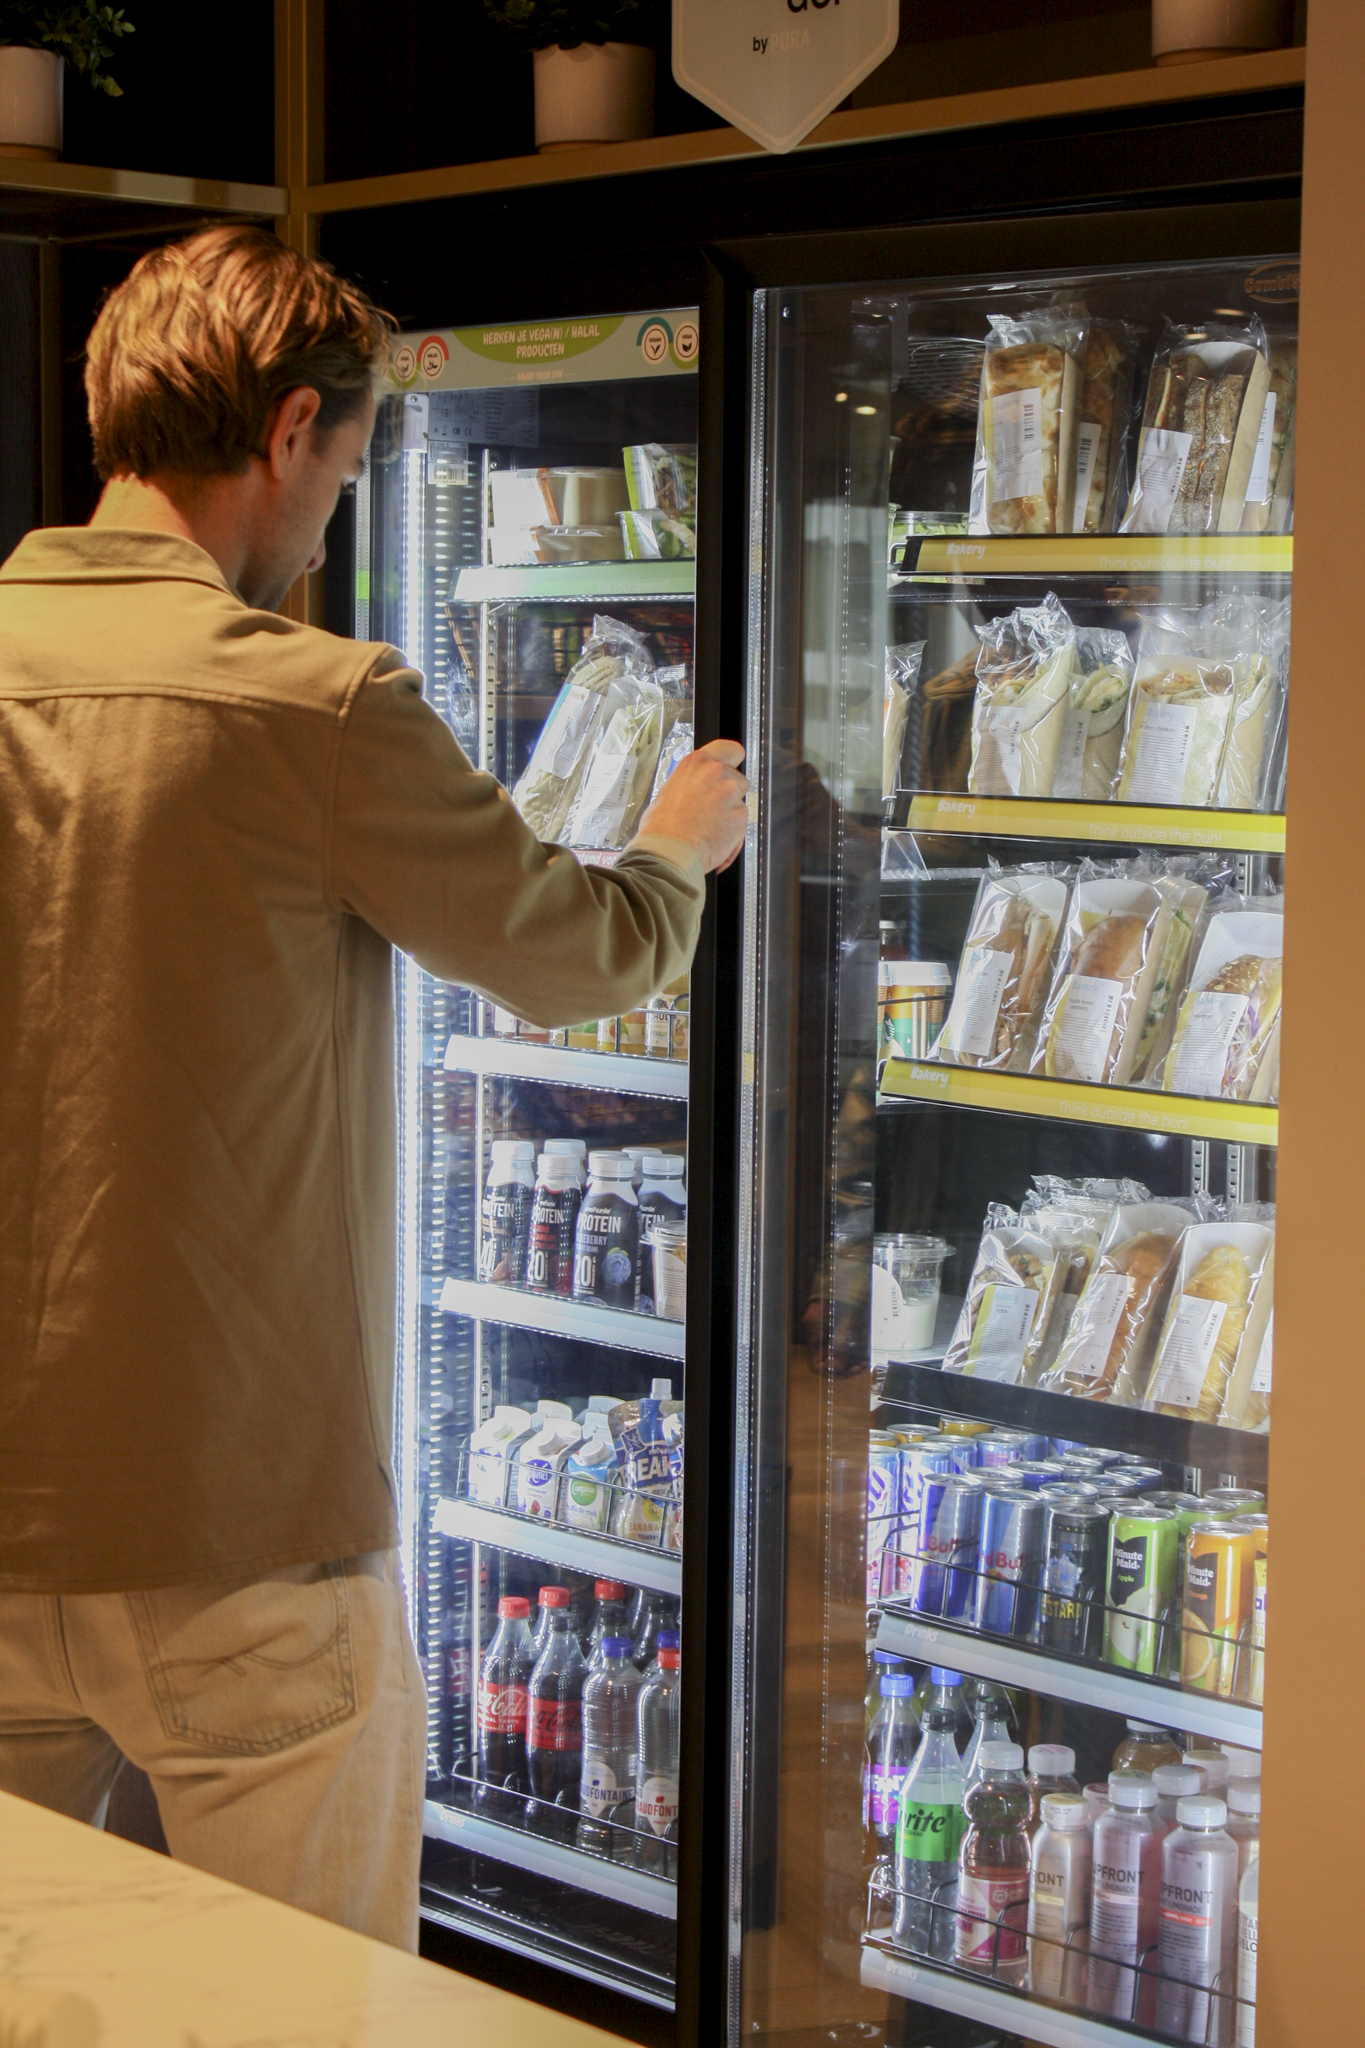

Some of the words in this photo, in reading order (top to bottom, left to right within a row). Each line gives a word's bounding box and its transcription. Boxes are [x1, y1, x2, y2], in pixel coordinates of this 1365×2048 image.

[753, 36, 768, 54] by
[770, 27, 811, 52] PURA
[483, 330, 515, 345] HERKEN
[517, 330, 527, 342] JE
[529, 326, 563, 341] VEGA(N)
[571, 324, 600, 338] HALAL
[516, 343, 565, 359] PRODUCTEN
[517, 373, 534, 381] ENJOY
[551, 369, 563, 379] DAY
[946, 543, 985, 558] Bakery
[1098, 557, 1128, 569] Think
[1130, 556, 1178, 569] outside
[1180, 556, 1201, 569] the
[1203, 556, 1234, 569] bun!
[597, 582, 611, 593] Eat
[612, 583, 632, 593] your
[634, 580, 669, 593] greens!
[937, 799, 976, 818] Bakery
[1088, 824, 1118, 838] Think
[1120, 824, 1167, 842] outside
[1169, 827, 1190, 843] the
[1192, 829, 1223, 845] bun!
[576, 852, 602, 865] stemd
[910, 1066, 949, 1088] Bakery
[1058, 1101, 1088, 1117] Think
[1090, 1104, 1136, 1124] outside
[1138, 1110, 1159, 1126] the
[1161, 1113, 1190, 1130] bun!
[577, 1212, 622, 1233] PROTEIN
[574, 1253, 592, 1287] 20
[996, 1291, 1018, 1304] Bakery
[1179, 1299, 1204, 1316] akery
[628, 1522, 660, 1532] BANANA
[1114, 1548, 1143, 1561] Minute
[1118, 1574, 1134, 1583] Apple
[905, 1623, 938, 1643] Drinks
[1093, 1690, 1129, 1709] Enjoy!
[439, 1810, 466, 1828] Drinks
[1102, 1882, 1136, 1894] LIMONADE
[1168, 1901, 1203, 1914] LIMONADE
[885, 1961, 918, 1981] Drinks
